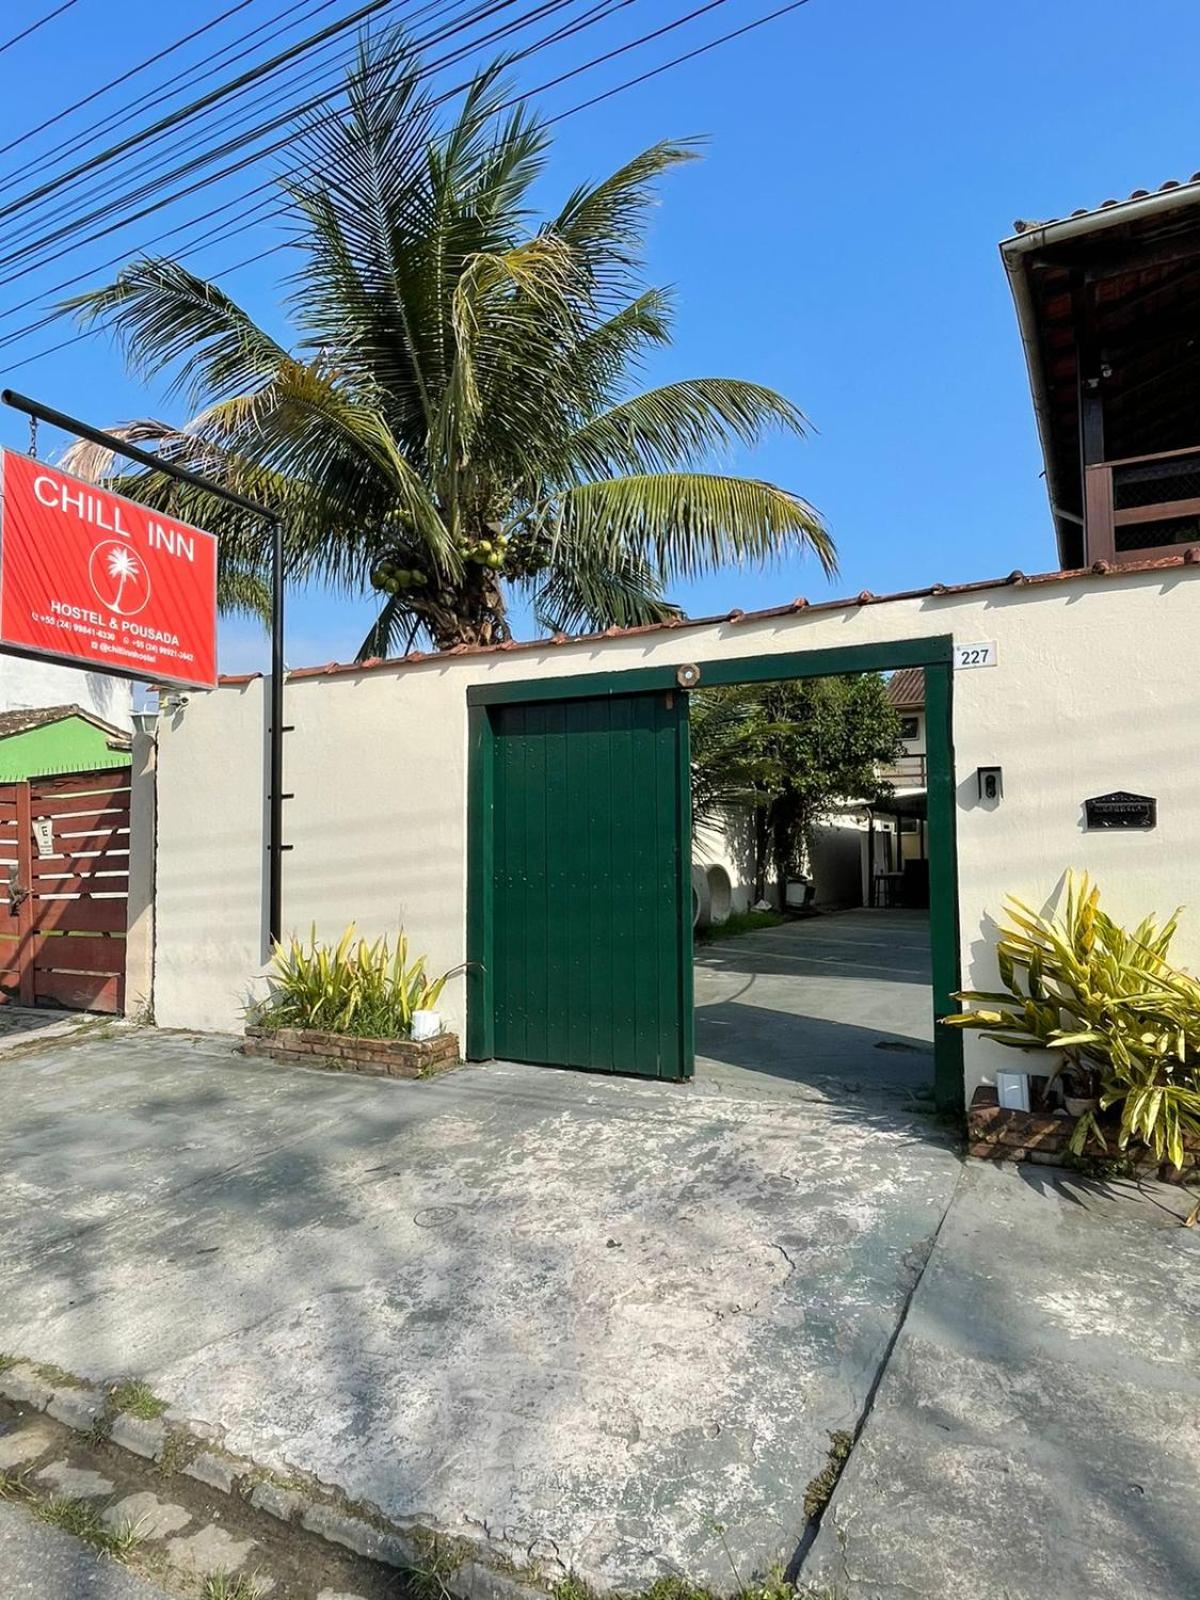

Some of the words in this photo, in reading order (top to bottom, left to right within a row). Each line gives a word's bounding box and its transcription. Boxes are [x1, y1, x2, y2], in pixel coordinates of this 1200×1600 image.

[34, 476, 130, 537] CHILL
[149, 521, 194, 562] INN
[51, 600, 106, 626] HOSTEL
[109, 618, 119, 630] &
[122, 621, 180, 646] POUSADA
[961, 649, 989, 665] 227
